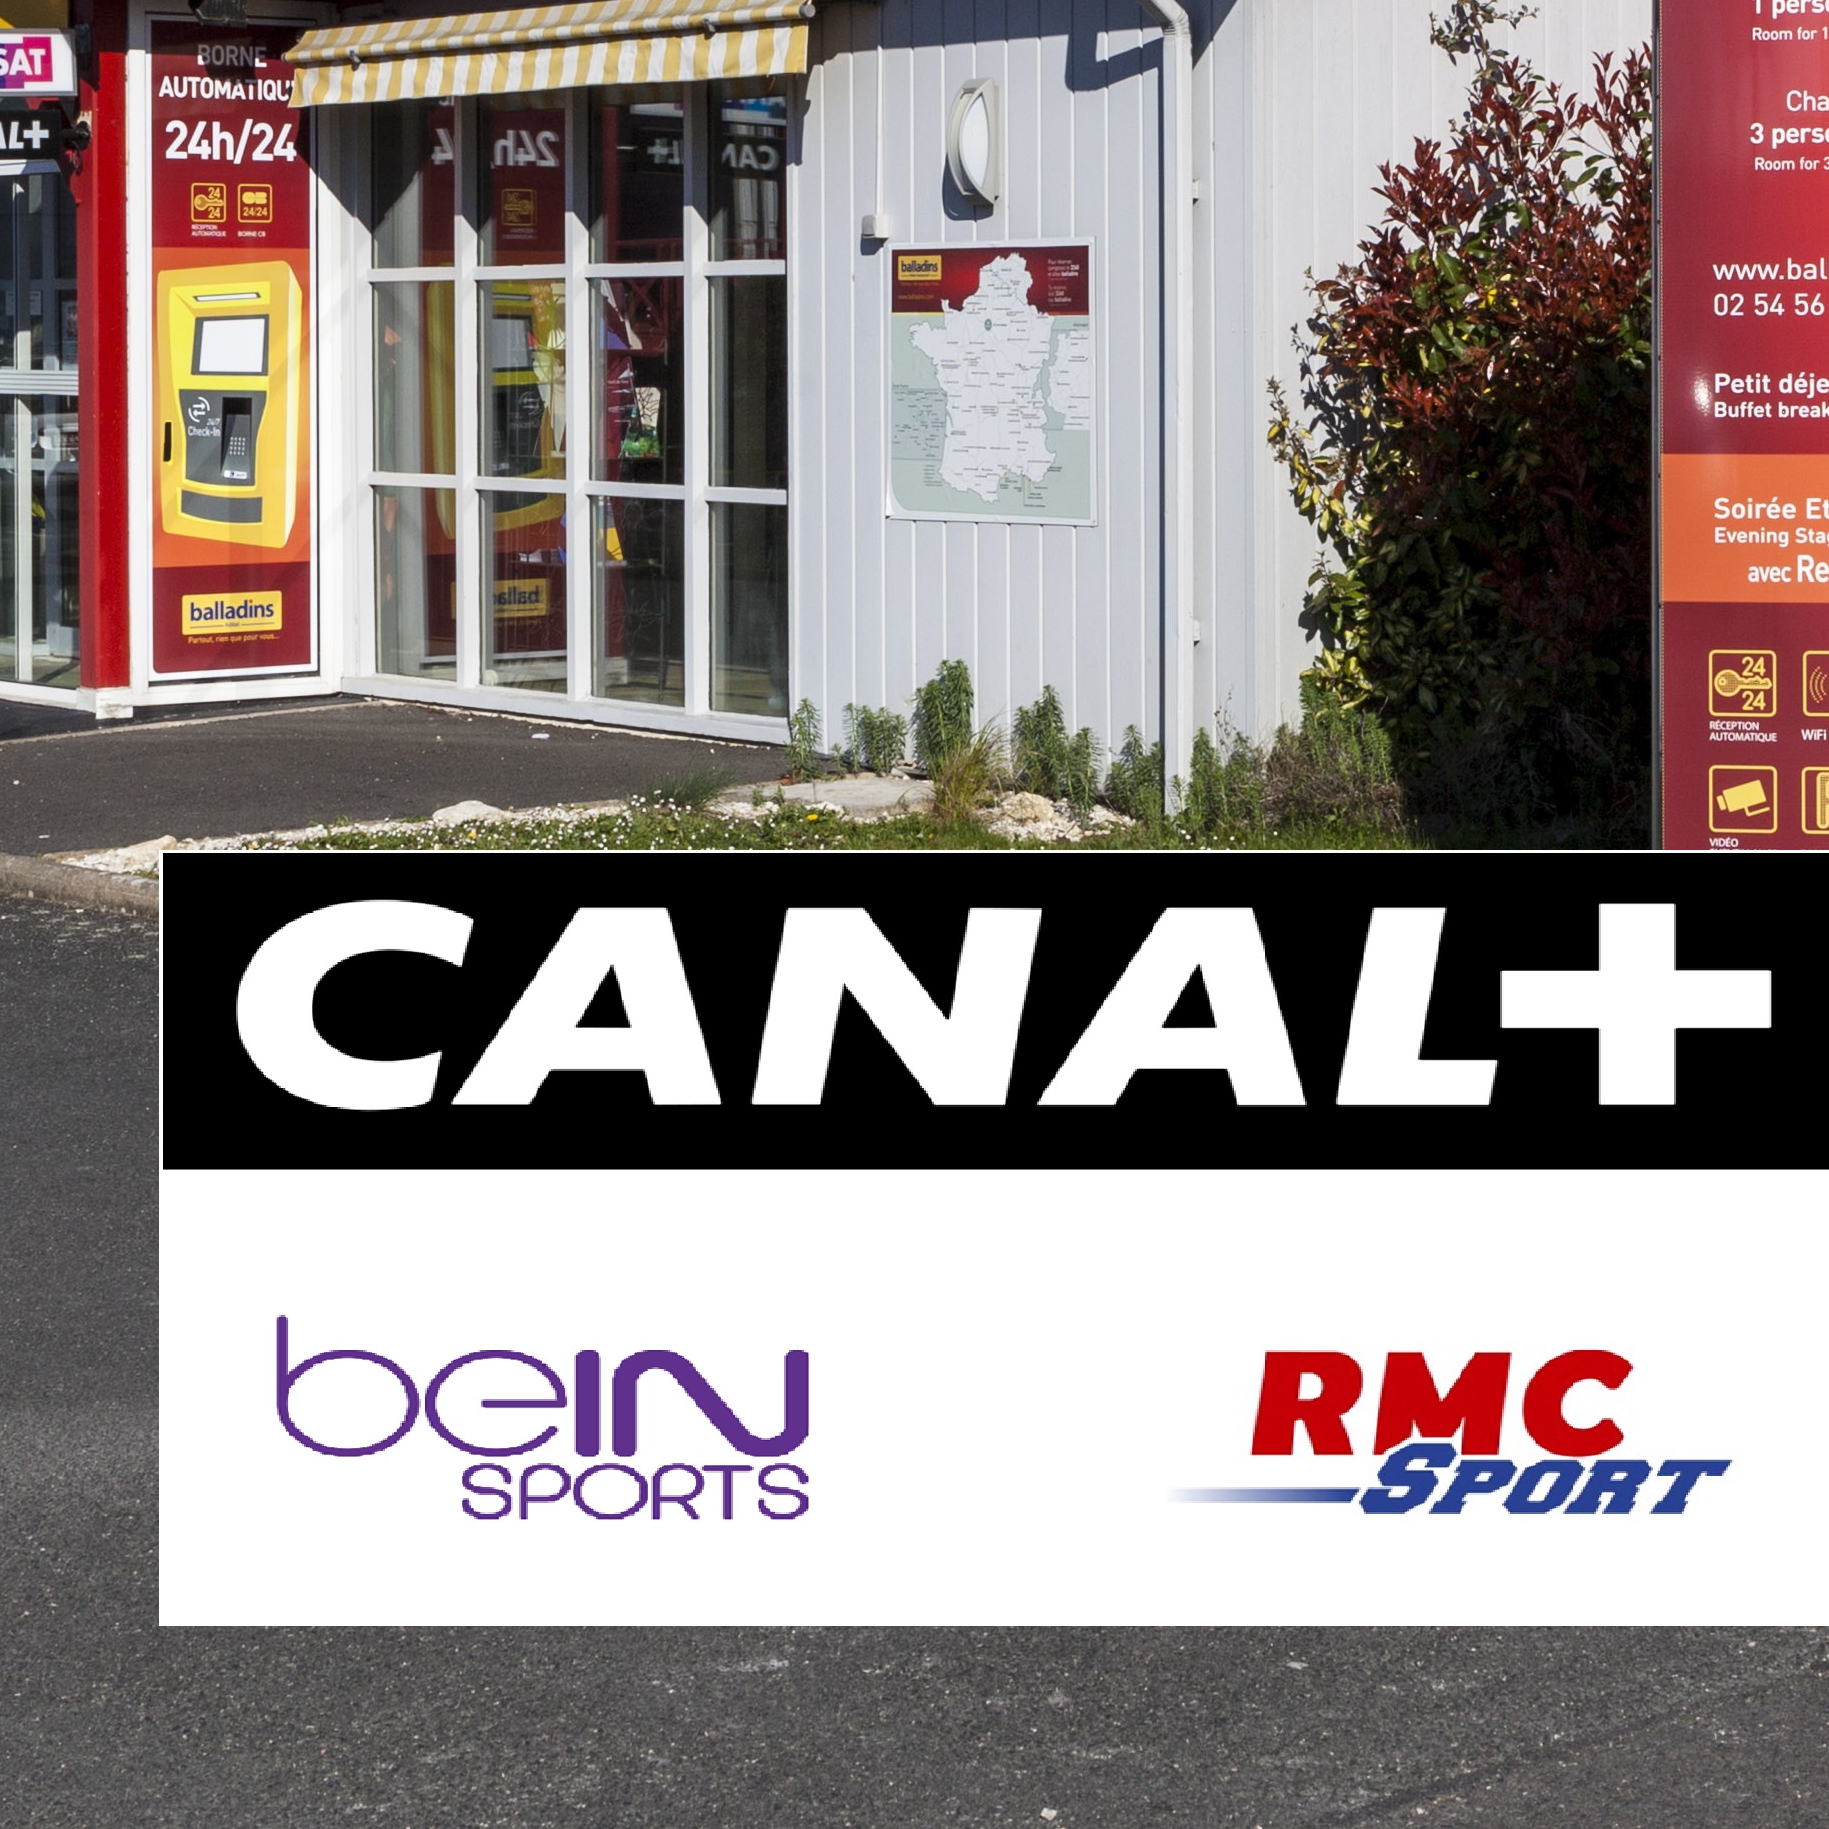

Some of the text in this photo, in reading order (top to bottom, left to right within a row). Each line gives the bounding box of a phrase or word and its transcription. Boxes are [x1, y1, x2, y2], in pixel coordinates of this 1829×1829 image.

[1752, 27, 1792, 41] Room
[1796, 26, 1818, 41] for
[1822, 26, 1829, 40] 1
[198, 44, 267, 68] BORNE
[159, 76, 295, 101] AUTOMATIQU
[165, 119, 297, 165] 24h/24
[1750, 123, 1764, 144] 3
[1754, 157, 1794, 172] Room
[1799, 156, 1820, 171] for
[208, 187, 220, 199] 24
[208, 207, 220, 219] 24
[243, 207, 267, 217] 24/24
[901, 260, 938, 273] balladins
[1713, 294, 1745, 317] 02
[1754, 294, 1785, 317] 54
[1794, 294, 1824, 316] 56
[1713, 373, 1771, 396] Petit
[1713, 402, 1772, 419] Buffet
[1713, 496, 1796, 520] Soirée
[1714, 528, 1789, 547] Evening
[1747, 566, 1792, 583] avec
[190, 599, 274, 621] balladins
[1742, 656, 1766, 677] 24
[1742, 691, 1766, 711] 24
[1709, 720, 1760, 731] RÉCEPTION
[1709, 732, 1777, 743] AUTOMATIQUE
[1801, 729, 1827, 741] WiFi
[1709, 837, 1739, 847] VIDÉO
